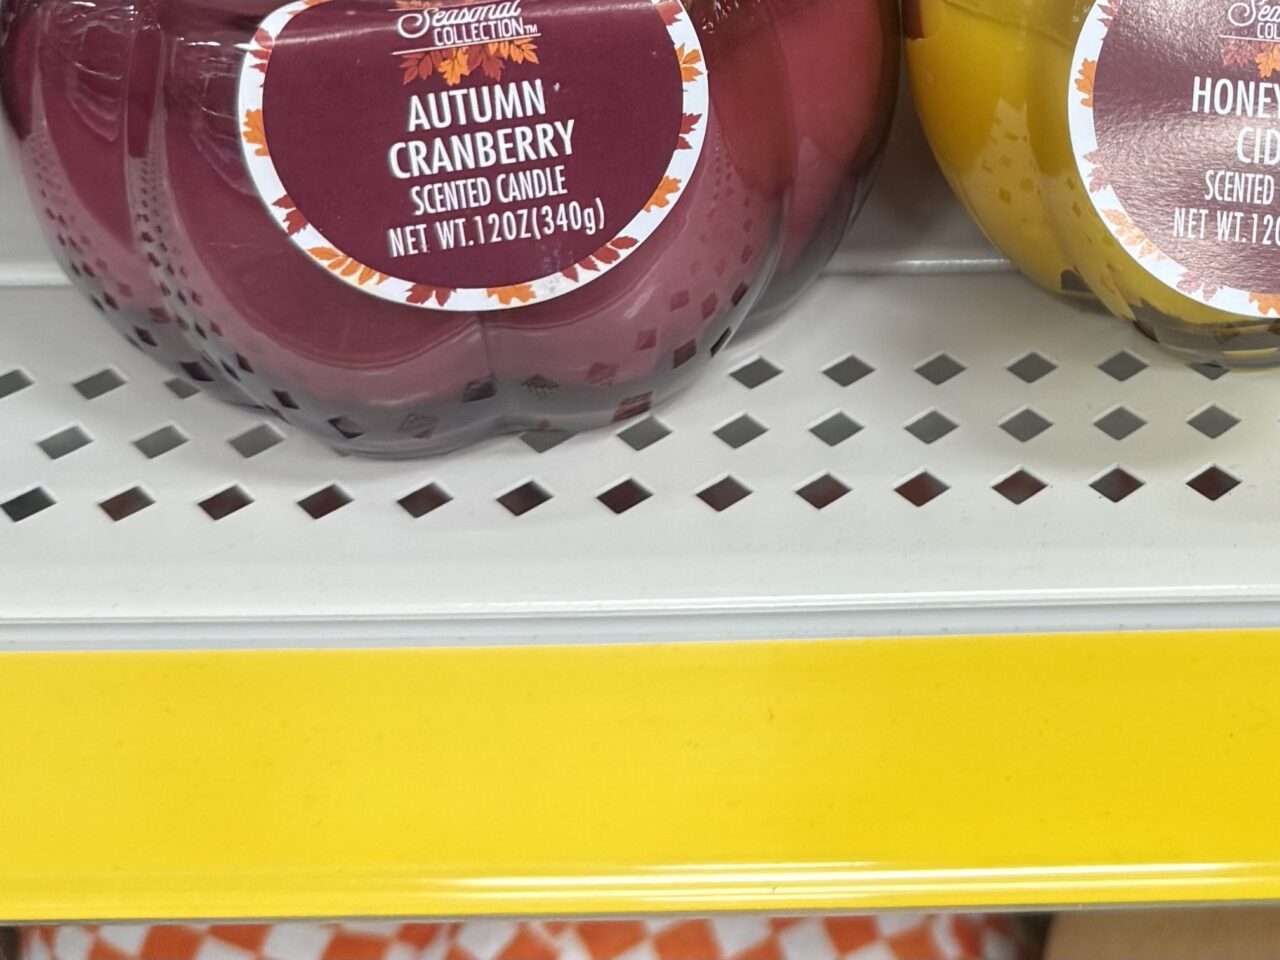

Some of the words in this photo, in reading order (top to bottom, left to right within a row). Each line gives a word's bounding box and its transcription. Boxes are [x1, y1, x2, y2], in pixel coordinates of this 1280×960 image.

[407, 78, 546, 132] AUTUMN
[387, 119, 575, 179] CRANBERRY
[411, 176, 492, 216] SCENTED
[496, 165, 568, 204] CANDLE
[1204, 169, 1275, 206] SCENTED
[387, 224, 428, 258] NET
[1173, 206, 1209, 240] NET
